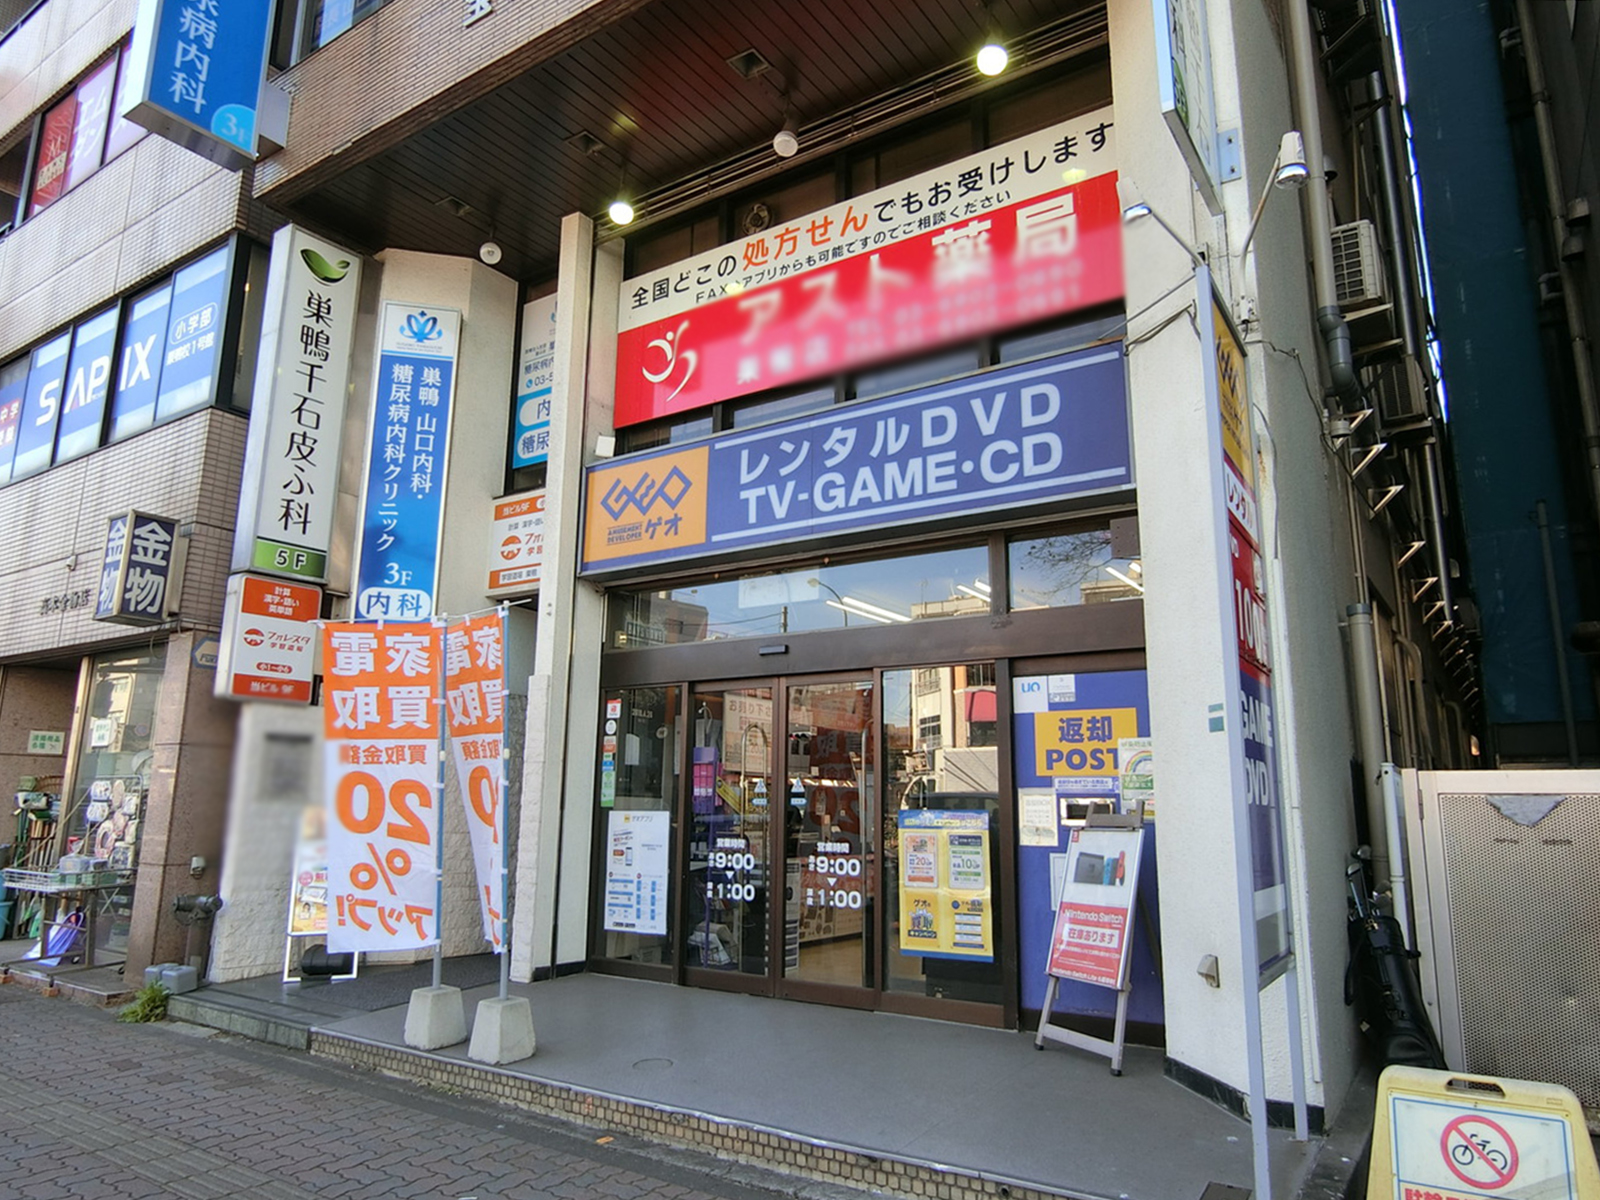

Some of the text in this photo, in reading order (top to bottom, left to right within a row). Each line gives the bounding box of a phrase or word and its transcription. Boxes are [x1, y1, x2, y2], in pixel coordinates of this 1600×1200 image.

[631, 121, 1113, 309] 全国どこの処方せんでもお受けします
[696, 188, 1010, 303] FAXアプリからも可能ですのでご相談ください
[36, 335, 157, 426] SAPIX
[419, 366, 442, 407] 巣鴨
[278, 289, 333, 535] 巣鴨千石皮ふ科
[377, 363, 414, 552] 糖尿病内科クリニック
[608, 523, 643, 535] AMUSEMENT
[608, 532, 643, 544] DEVELOPER
[645, 513, 683, 540] ゲオ
[125, 521, 172, 614] 金物
[276, 549, 307, 570] 5F
[384, 563, 412, 586] 3F
[367, 592, 422, 616] 内科
[268, 631, 311, 644] フォレスタ
[1058, 716, 1113, 743] 返却
[1046, 748, 1119, 771] POST
[1245, 757, 1269, 806] DVD
[715, 852, 755, 871] 9:00
[815, 856, 860, 876] 9:00
[716, 883, 756, 902] 1:00
[817, 888, 862, 909] 1:00
[1064, 909, 1124, 924] Nintendo Switch
